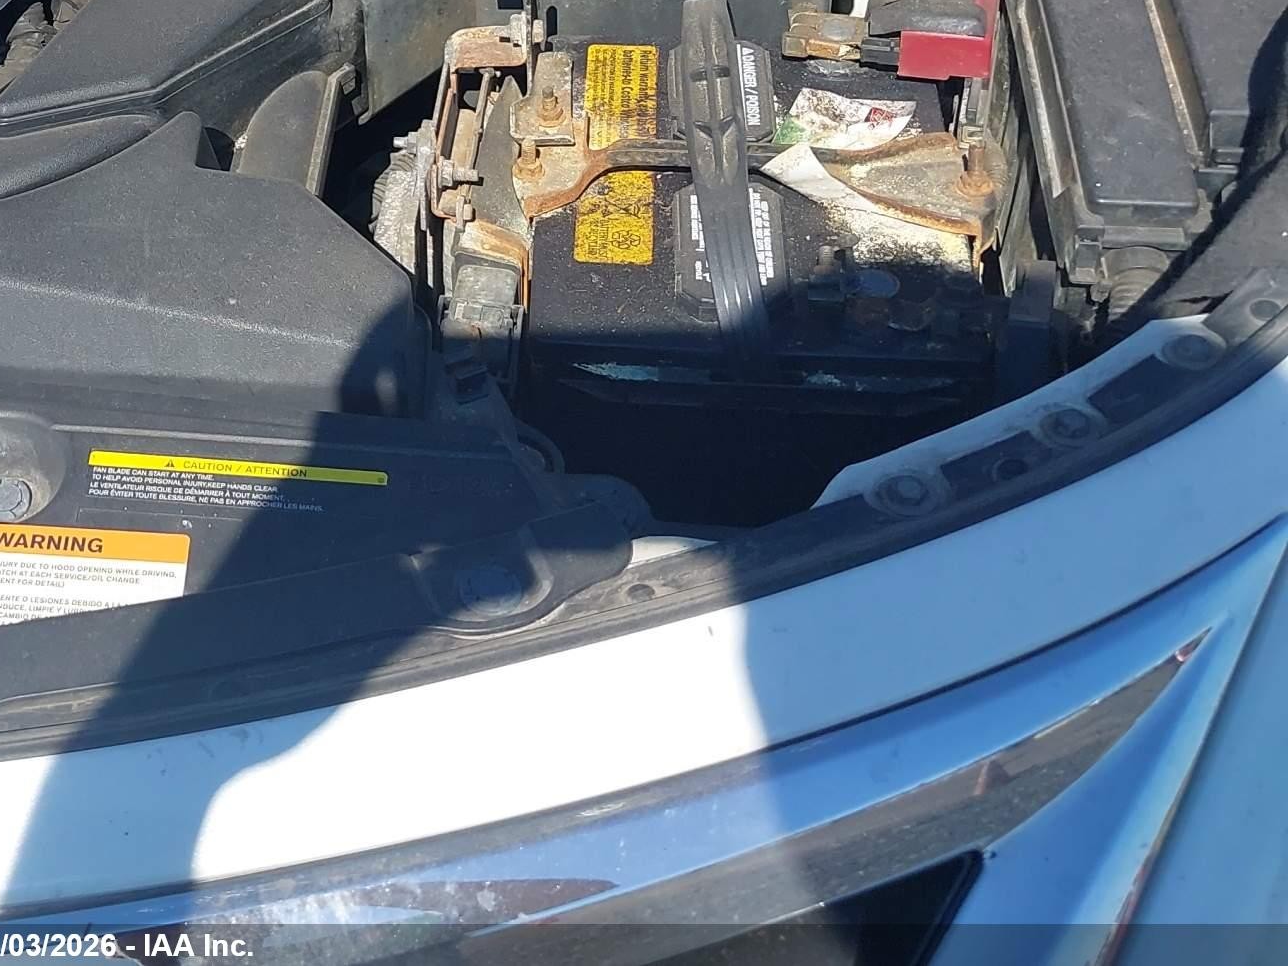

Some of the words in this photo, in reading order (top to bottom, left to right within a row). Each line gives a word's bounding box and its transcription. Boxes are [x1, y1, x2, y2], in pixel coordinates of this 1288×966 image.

[742, 56, 757, 87] DANGER
[621, 87, 632, 108] Costco
[746, 95, 760, 125] POISON
[183, 461, 232, 472] CAUTION
[246, 466, 307, 478] ATTENTION
[77, 565, 113, 574] OPENING
[28, 605, 55, 613] LIMPIE
[30, 596, 69, 605] LESIONES
